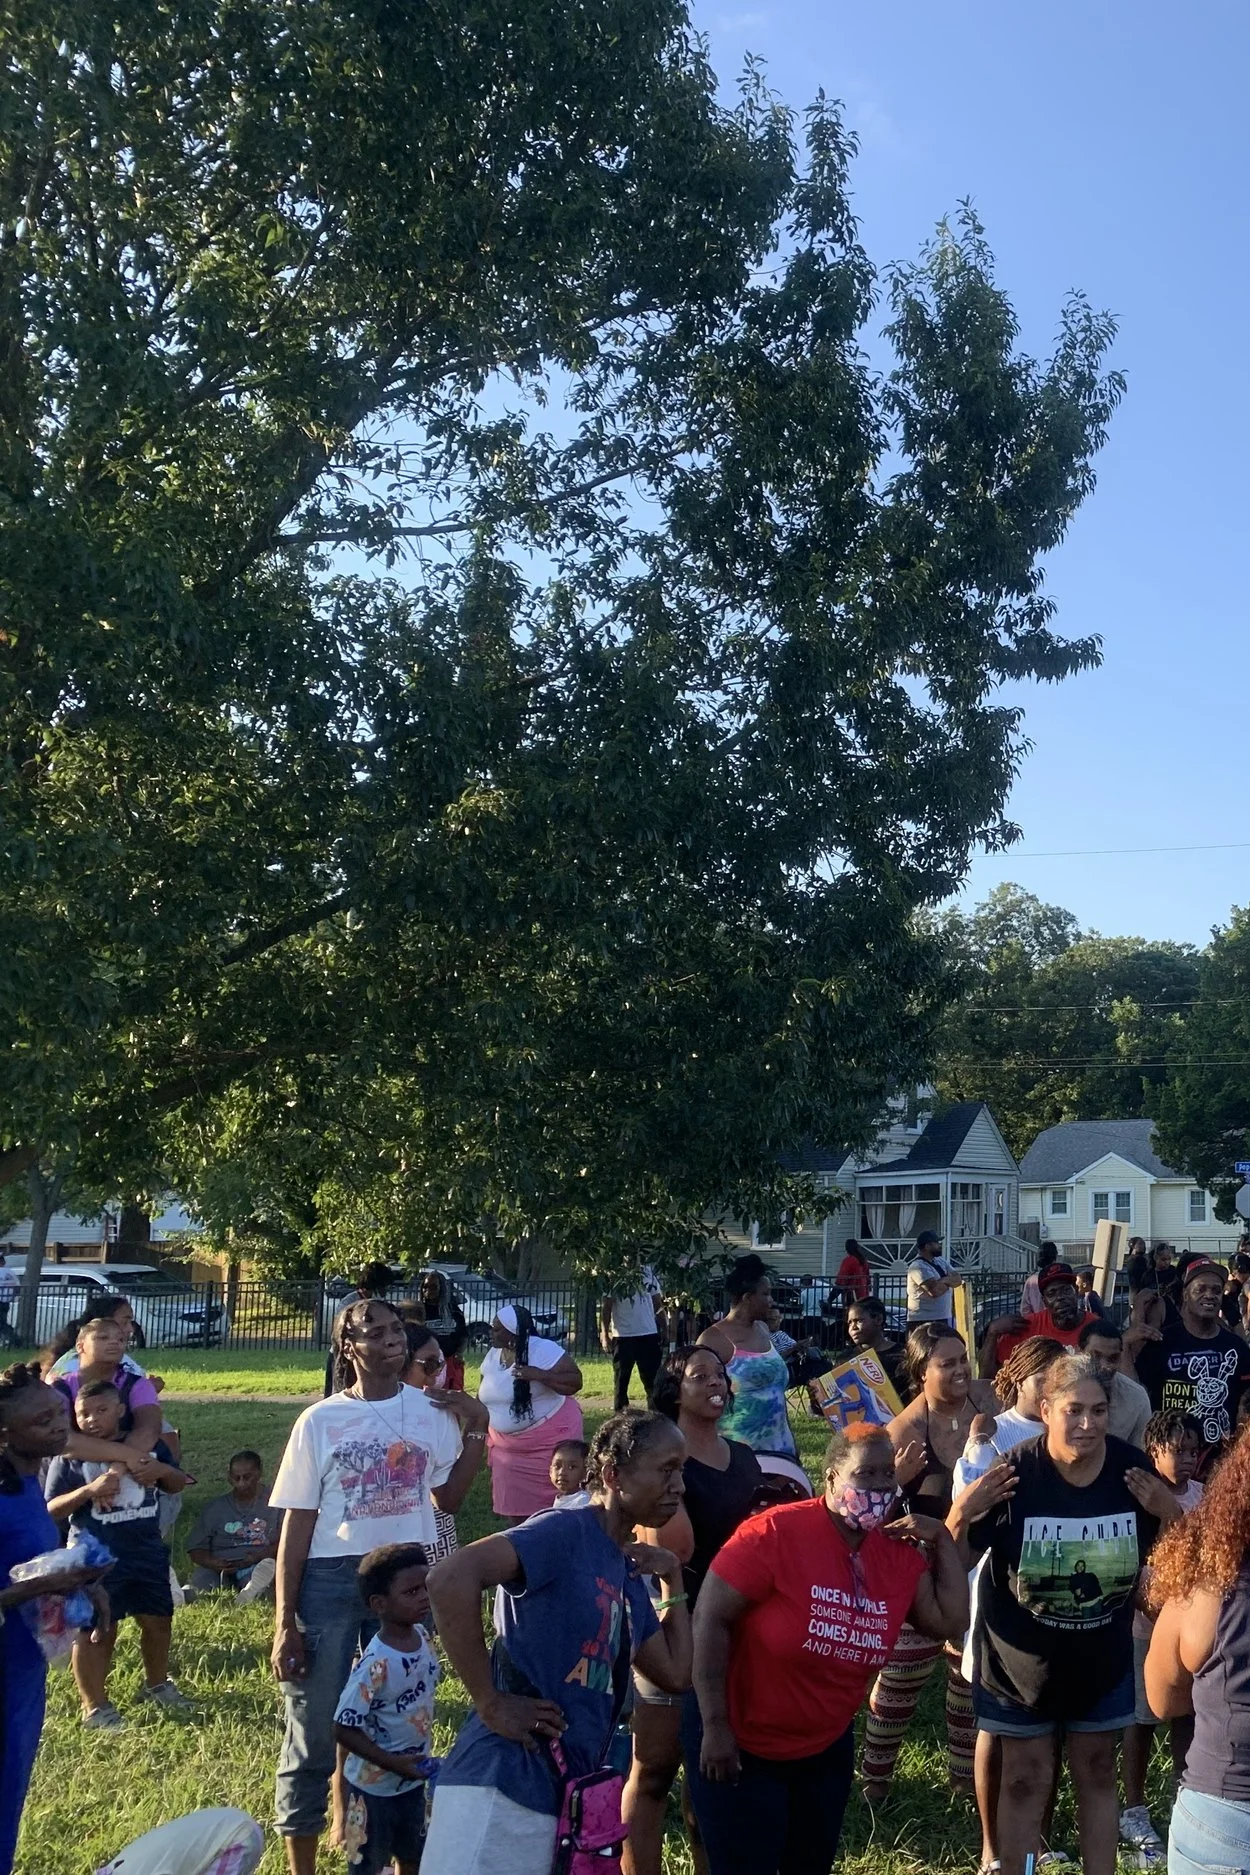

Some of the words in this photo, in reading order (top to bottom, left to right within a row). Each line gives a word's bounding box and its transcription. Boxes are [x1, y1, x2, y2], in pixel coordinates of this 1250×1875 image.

[860, 1357, 884, 1385] NERF
[1027, 1524, 1062, 1558] ICE
[1082, 1519, 1135, 1557] CUBE
[811, 1584, 841, 1604] ONCE
[808, 1618, 848, 1643] COMES
[810, 1603, 852, 1625] SOMEONE
[853, 1615, 888, 1631] AMAZING
[1059, 1622, 1075, 1630] WAS
[1082, 1621, 1101, 1630] GOOD
[1101, 1616, 1112, 1626] DAY
[802, 1638, 832, 1656] AND
[833, 1645, 862, 1662] HERE
[863, 1653, 868, 1664] I
[869, 1654, 886, 1666] AM
